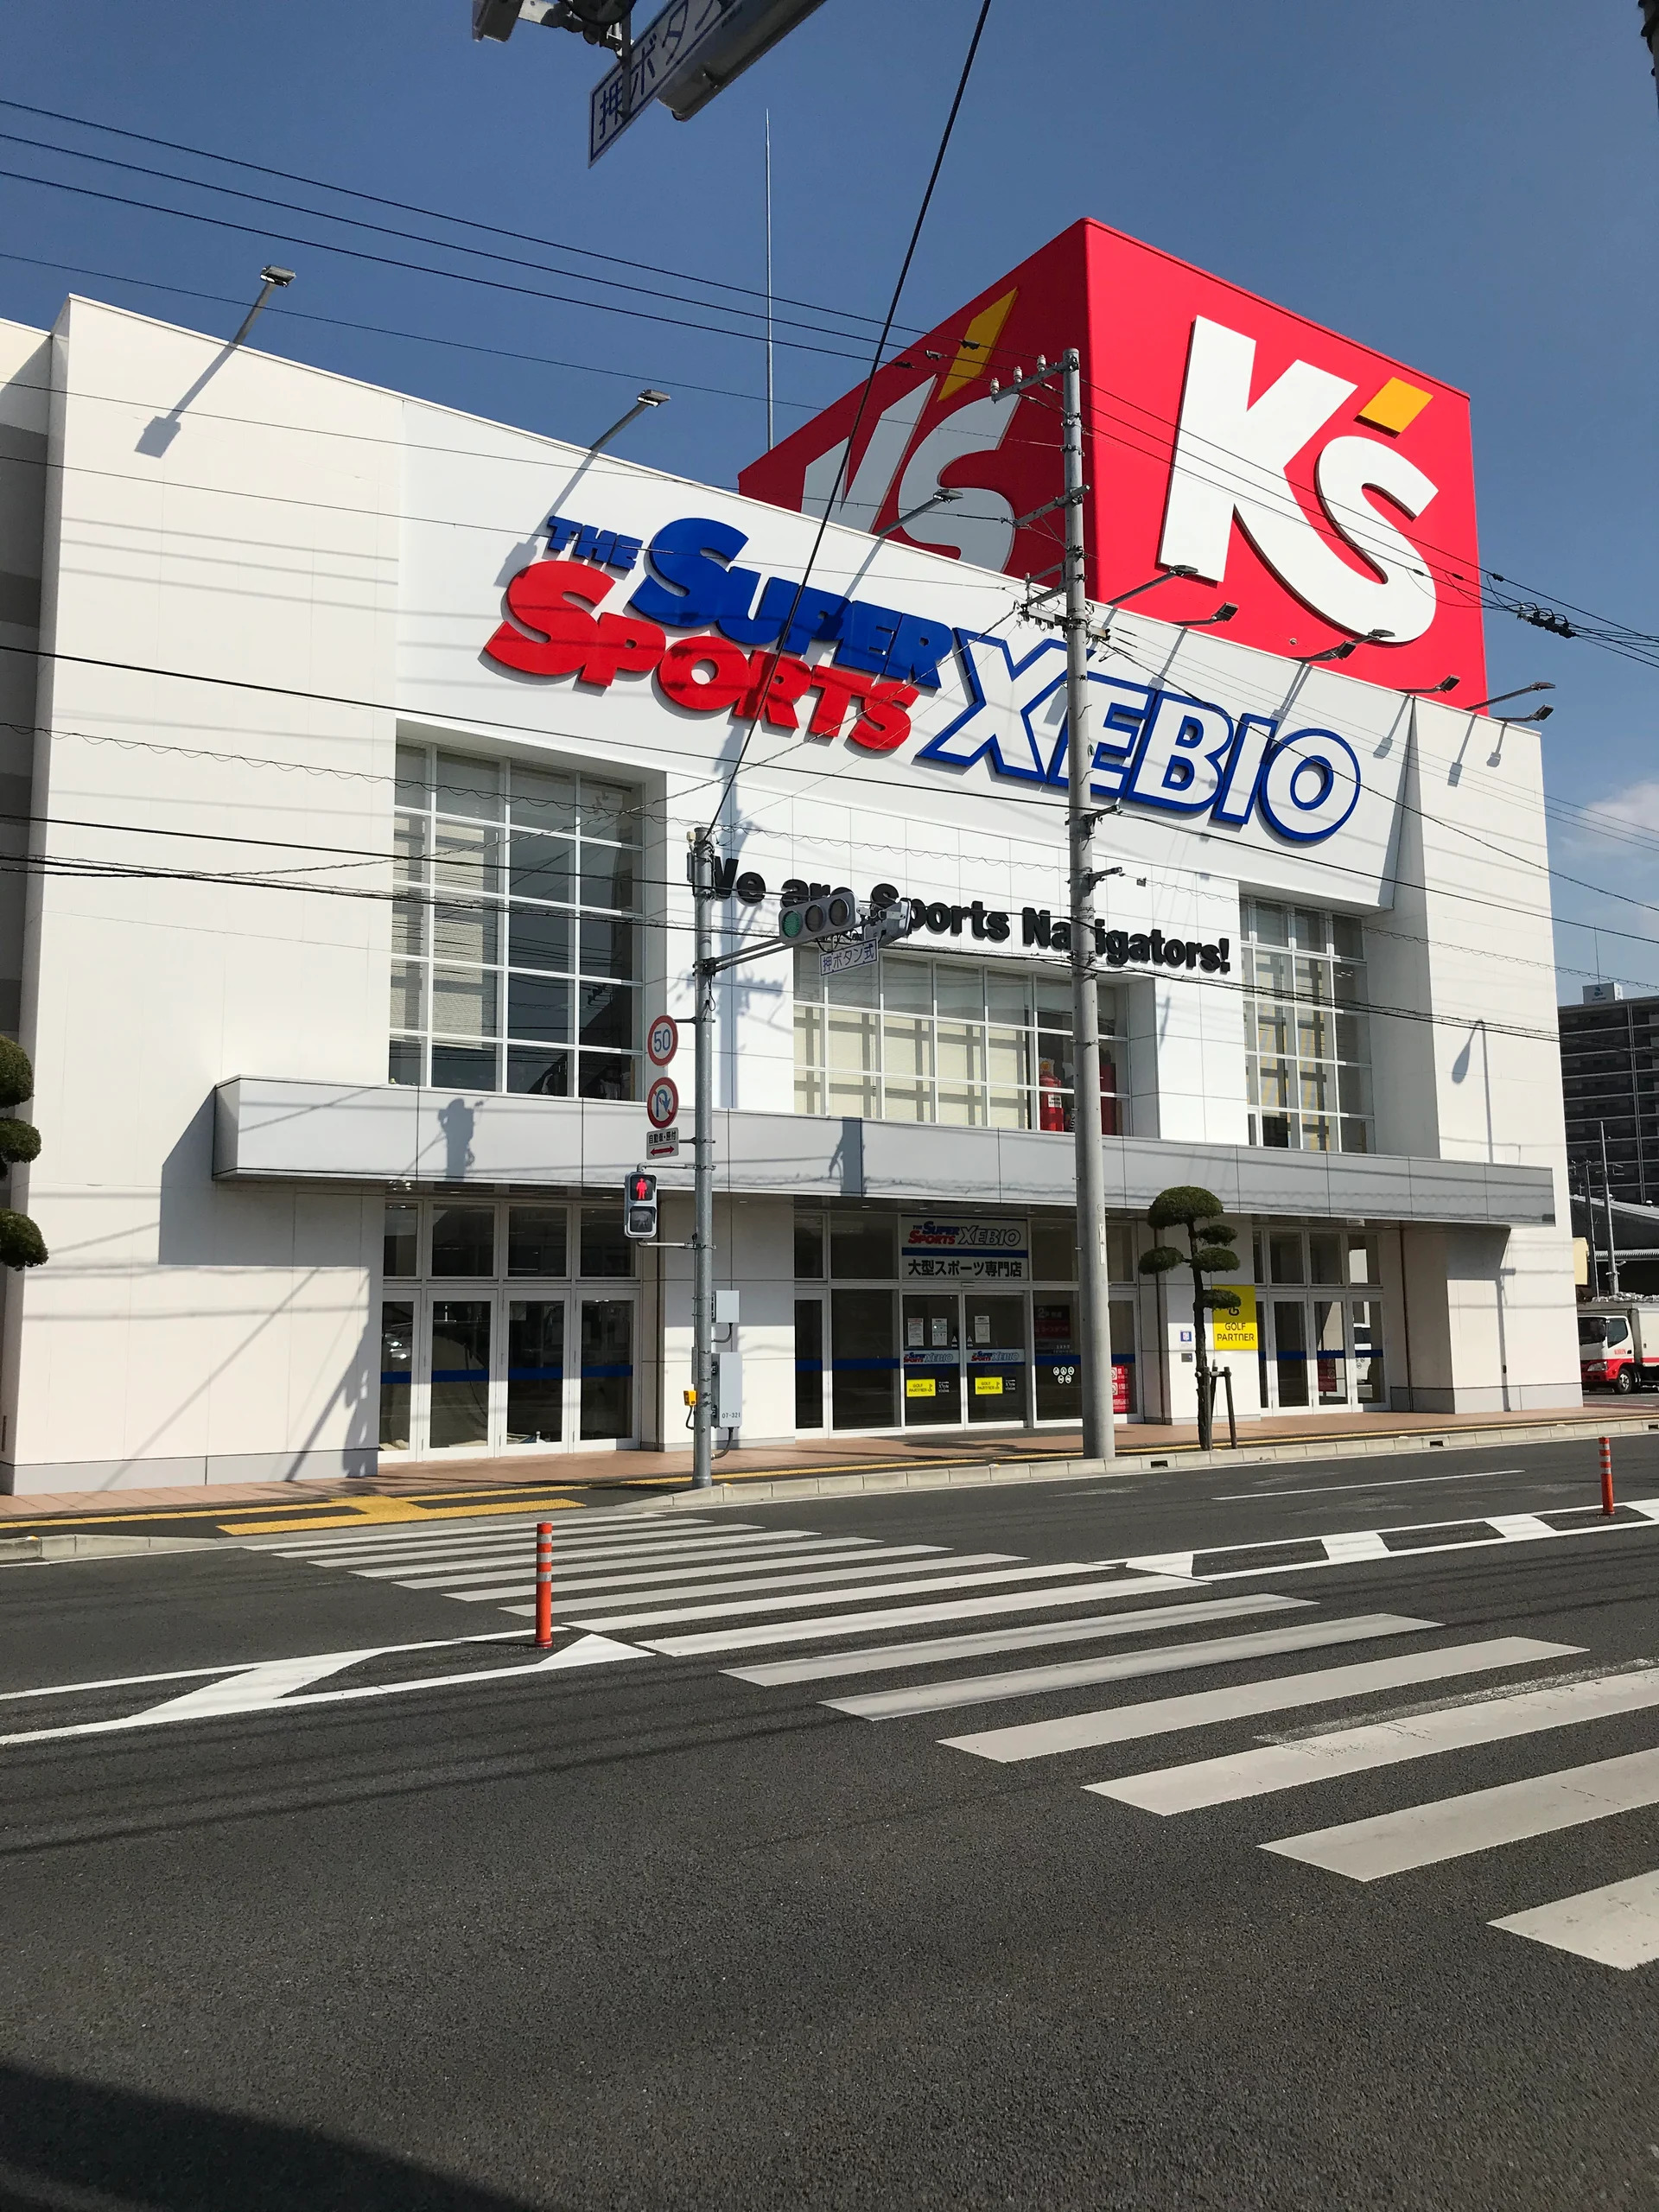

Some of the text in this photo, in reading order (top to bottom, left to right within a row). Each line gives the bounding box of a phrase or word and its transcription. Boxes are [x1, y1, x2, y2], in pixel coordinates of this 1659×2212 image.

[548, 515, 954, 690] THE SUPER
[485, 560, 921, 750] SPORTS
[916, 627, 1361, 842] XEBIO
[1022, 906, 1230, 973] Naigators!
[823, 944, 874, 971] 押ボタン式
[654, 1028, 671, 1052] 50
[908, 1230, 956, 1244] SPORTS
[922, 1221, 960, 1236] SUPER
[958, 1225, 1021, 1247] XEBIO
[908, 1259, 1022, 1277] 大型スポーツ専門店
[1217, 1333, 1255, 1342] PARTNER
[1224, 1322, 1246, 1331] GOLF
